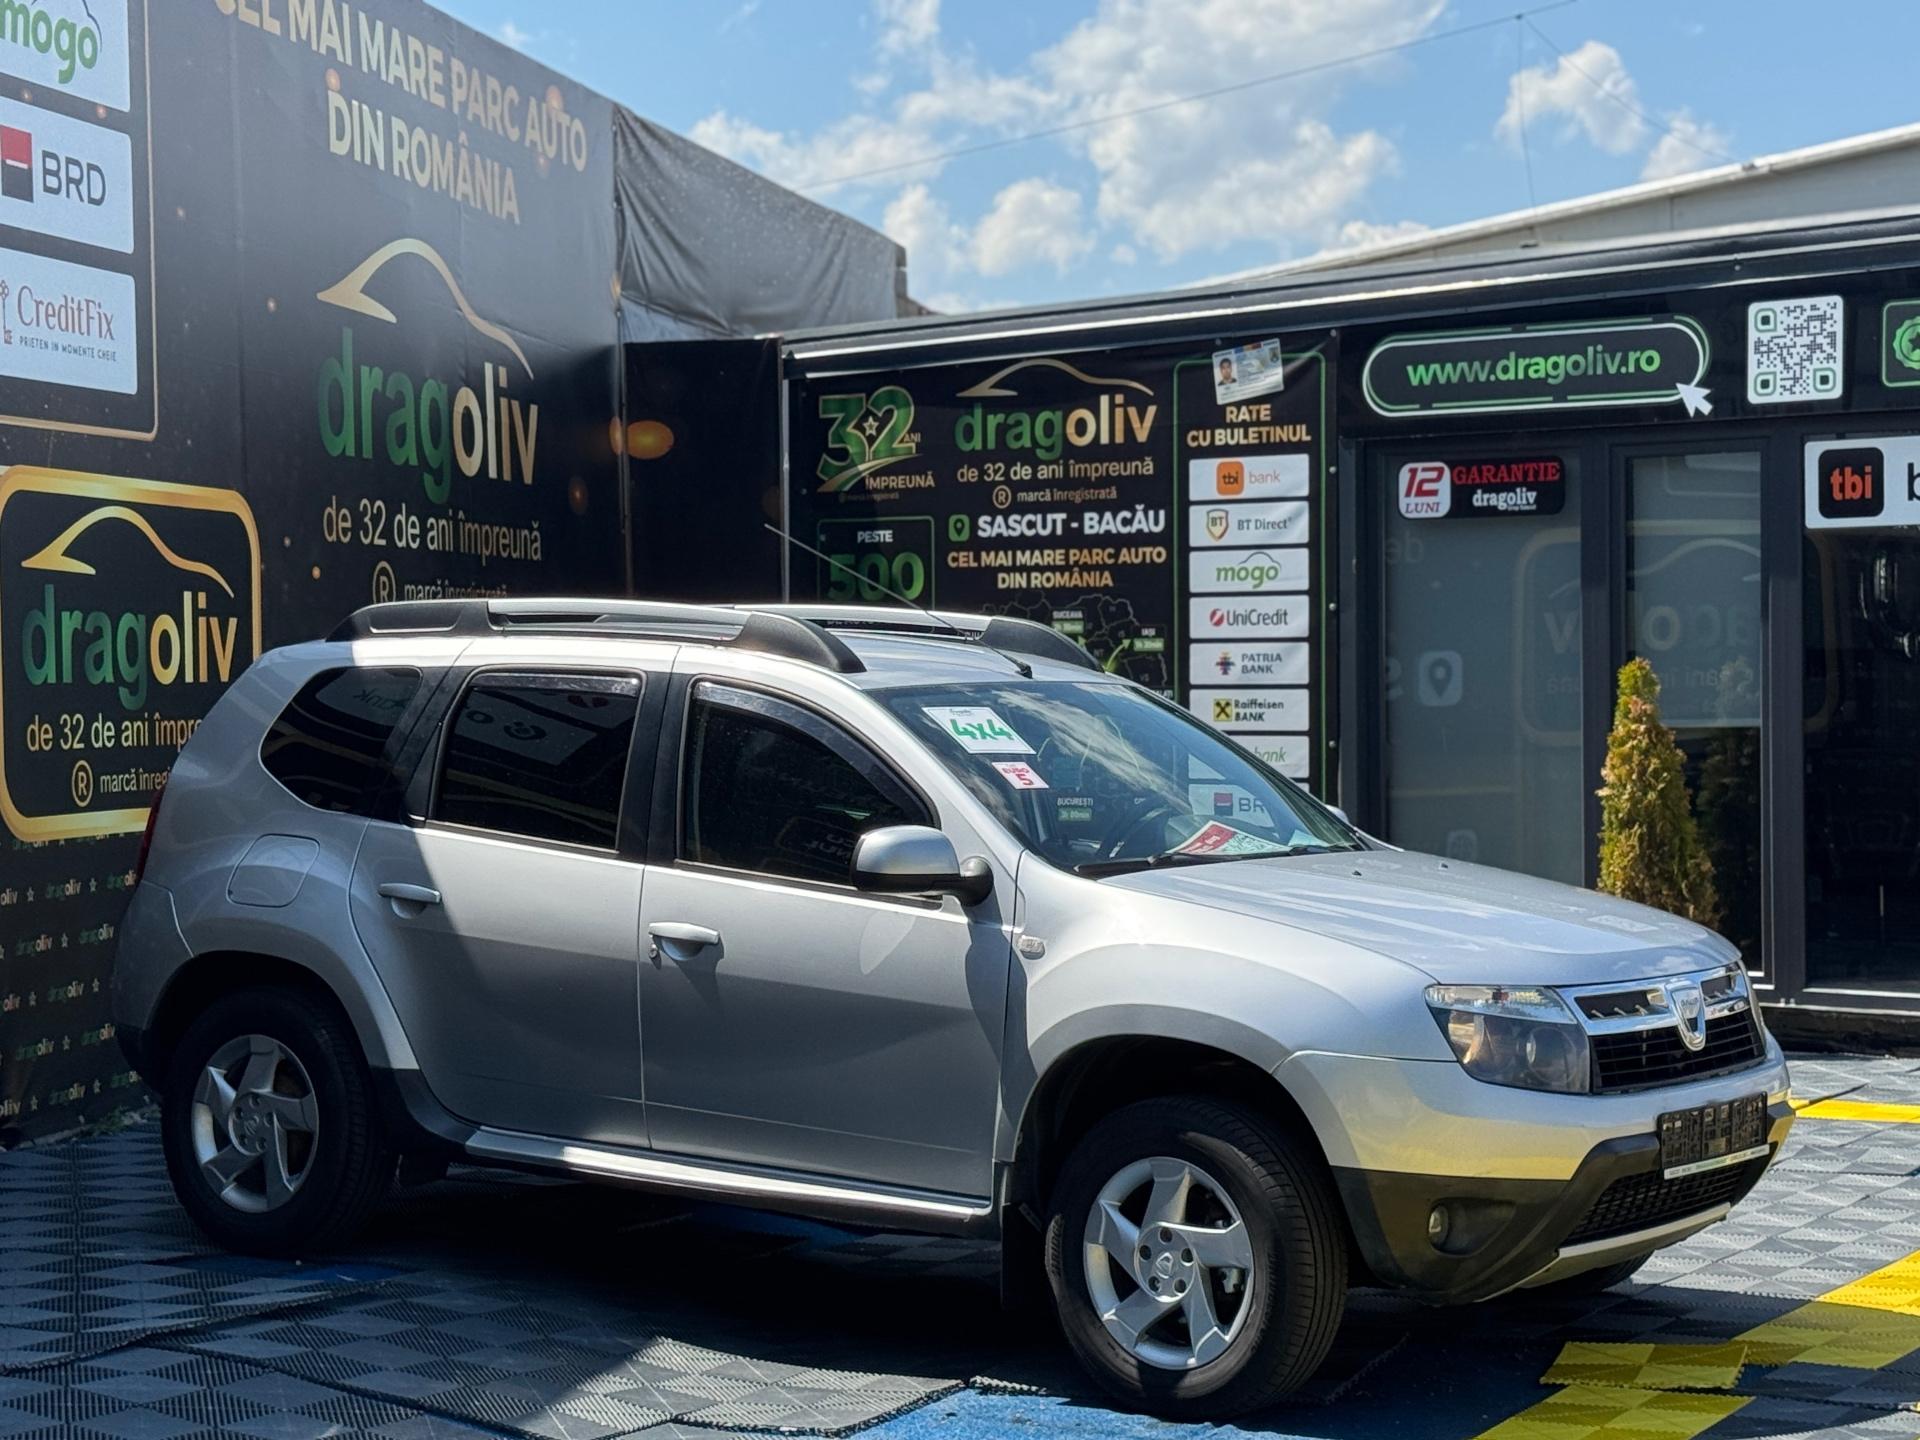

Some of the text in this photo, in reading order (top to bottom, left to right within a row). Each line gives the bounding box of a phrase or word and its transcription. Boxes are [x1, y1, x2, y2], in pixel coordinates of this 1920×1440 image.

[0, 0, 98, 84] mogo
[288, 0, 353, 66] MAI
[358, 11, 446, 108] MARE
[451, 57, 520, 142] PARC
[524, 97, 587, 172] AUTO
[327, 91, 520, 225] DIN ROMÂNIA
[42, 149, 106, 207] BRD
[18, 285, 115, 341] CreditFix
[20, 335, 49, 350] PRIETEN
[62, 344, 95, 359] MOMENTE
[98, 349, 117, 361] CHEIE
[1406, 345, 1661, 386] www.dragoliv.ro
[318, 326, 538, 504] dragoliv
[1226, 404, 1271, 423] RATE
[816, 386, 921, 482] 32 ANI
[954, 394, 1158, 460] dragoliv
[1187, 424, 1311, 447] CU BULETINUL
[865, 472, 936, 490] ÎMPREUNĂ
[957, 457, 1154, 482] de 32 de ani împreună
[1222, 470, 1280, 485] tbi bank
[1404, 461, 1560, 498] 12 GARANTIE
[1017, 488, 1051, 503] marcă
[1053, 486, 1117, 503] înregistrată
[1830, 466, 1872, 500] tbi
[1405, 486, 1537, 514] LUNI dragoliv
[323, 495, 542, 566] de 32 de ani împreună
[977, 513, 1067, 538] SASCUT
[1083, 504, 1165, 535] BACĂU
[1211, 517, 1224, 527] BT
[1237, 519, 1251, 531] BT
[857, 530, 894, 543] PESTE
[947, 546, 1167, 567] CEL MAI MARE PARC AUTO
[827, 552, 925, 600] 500
[997, 568, 1113, 588] DIN ROMÂNIA
[1216, 564, 1279, 589] mogo
[1227, 609, 1288, 626] UniCredit
[22, 584, 238, 710] dragoliv
[1241, 653, 1282, 662] PATRIA
[1241, 665, 1273, 674] BANK
[1234, 698, 1284, 710] Raiffeisen
[949, 719, 1015, 740] 4x4
[1234, 712, 1265, 722] BANK
[27, 715, 53, 751] de
[60, 713, 85, 750] 32
[91, 713, 115, 748] de
[121, 712, 149, 747] ani
[100, 768, 137, 792] marcă
[1015, 773, 1035, 786] 5
